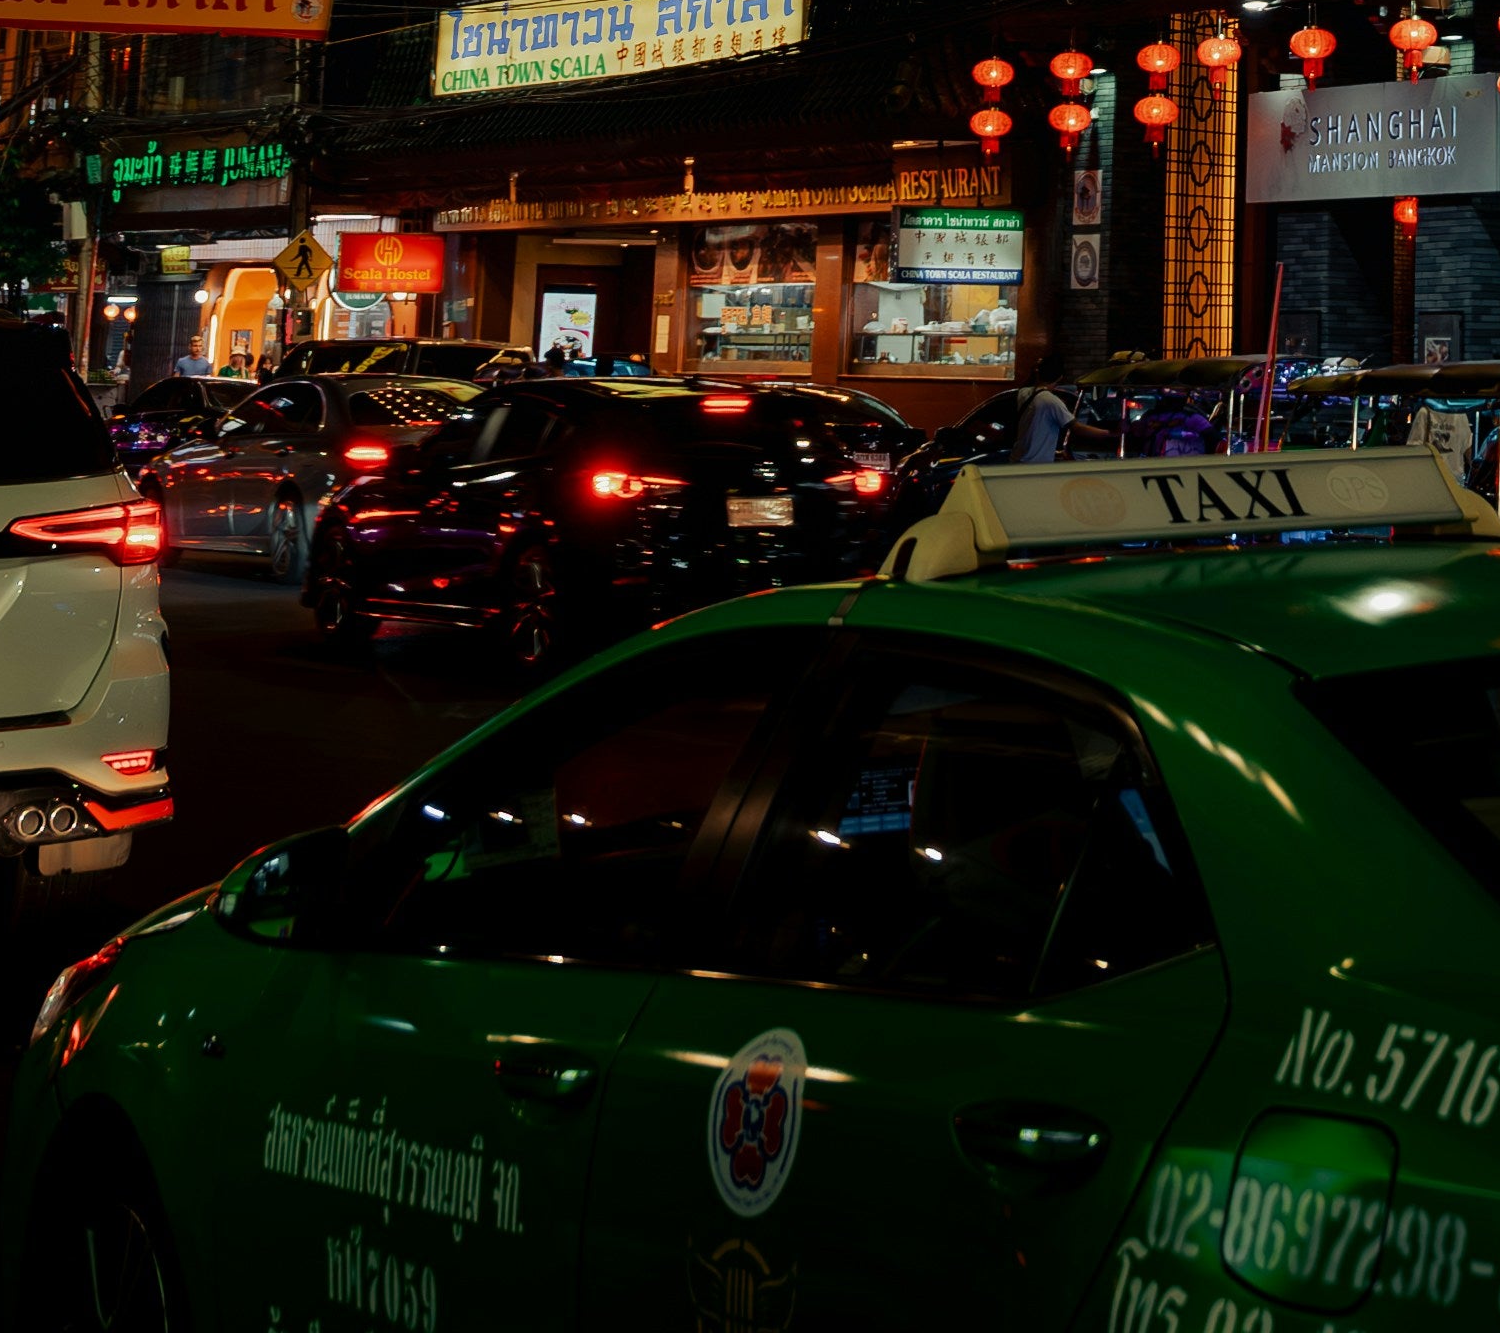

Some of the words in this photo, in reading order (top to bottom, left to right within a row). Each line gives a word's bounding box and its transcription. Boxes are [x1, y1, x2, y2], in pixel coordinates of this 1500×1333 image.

[441, 67, 491, 92] CHINA
[496, 59, 546, 87] TOWN
[548, 53, 607, 81] SCALA
[1308, 106, 1459, 147] SHANGHAI
[1307, 150, 1380, 174] MANSION
[1387, 145, 1458, 168] BANGKOK
[900, 165, 1001, 200] RESTAURANT
[343, 267, 383, 280] Scala
[386, 267, 432, 280] Hostel
[901, 269, 924, 279] CHINA
[948, 270, 971, 280] SCALA
[972, 270, 1018, 281] RESTAURANT
[1140, 468, 1311, 523] TAXI
[1330, 476, 1386, 503] GPS
